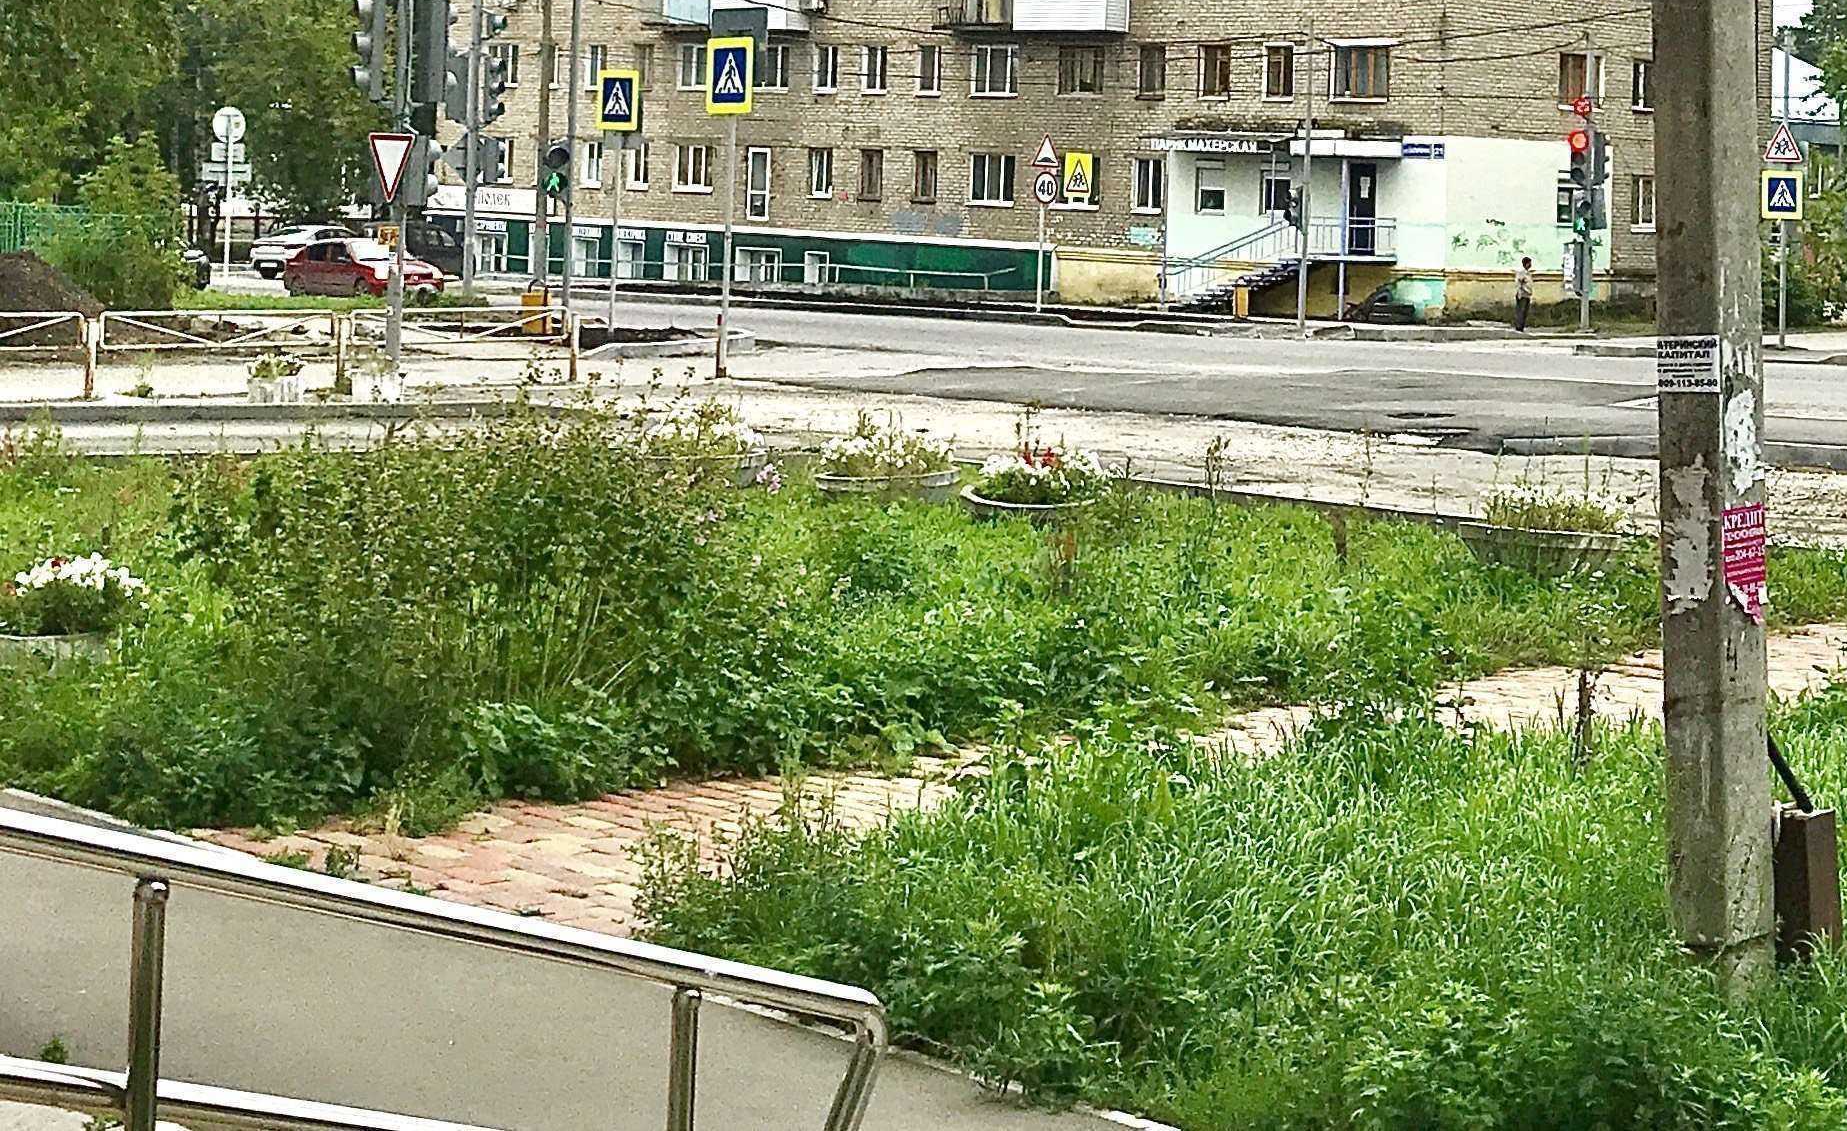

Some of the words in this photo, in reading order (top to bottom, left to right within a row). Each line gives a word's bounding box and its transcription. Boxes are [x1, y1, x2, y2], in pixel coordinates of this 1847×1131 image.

[1150, 139, 1257, 153] ПАРИКМАХЕРСКАЯ
[1038, 180, 1053, 196] 40
[1657, 350, 1710, 359] КАПИТАЛ
[1724, 510, 1764, 530] КРЕДИТ
